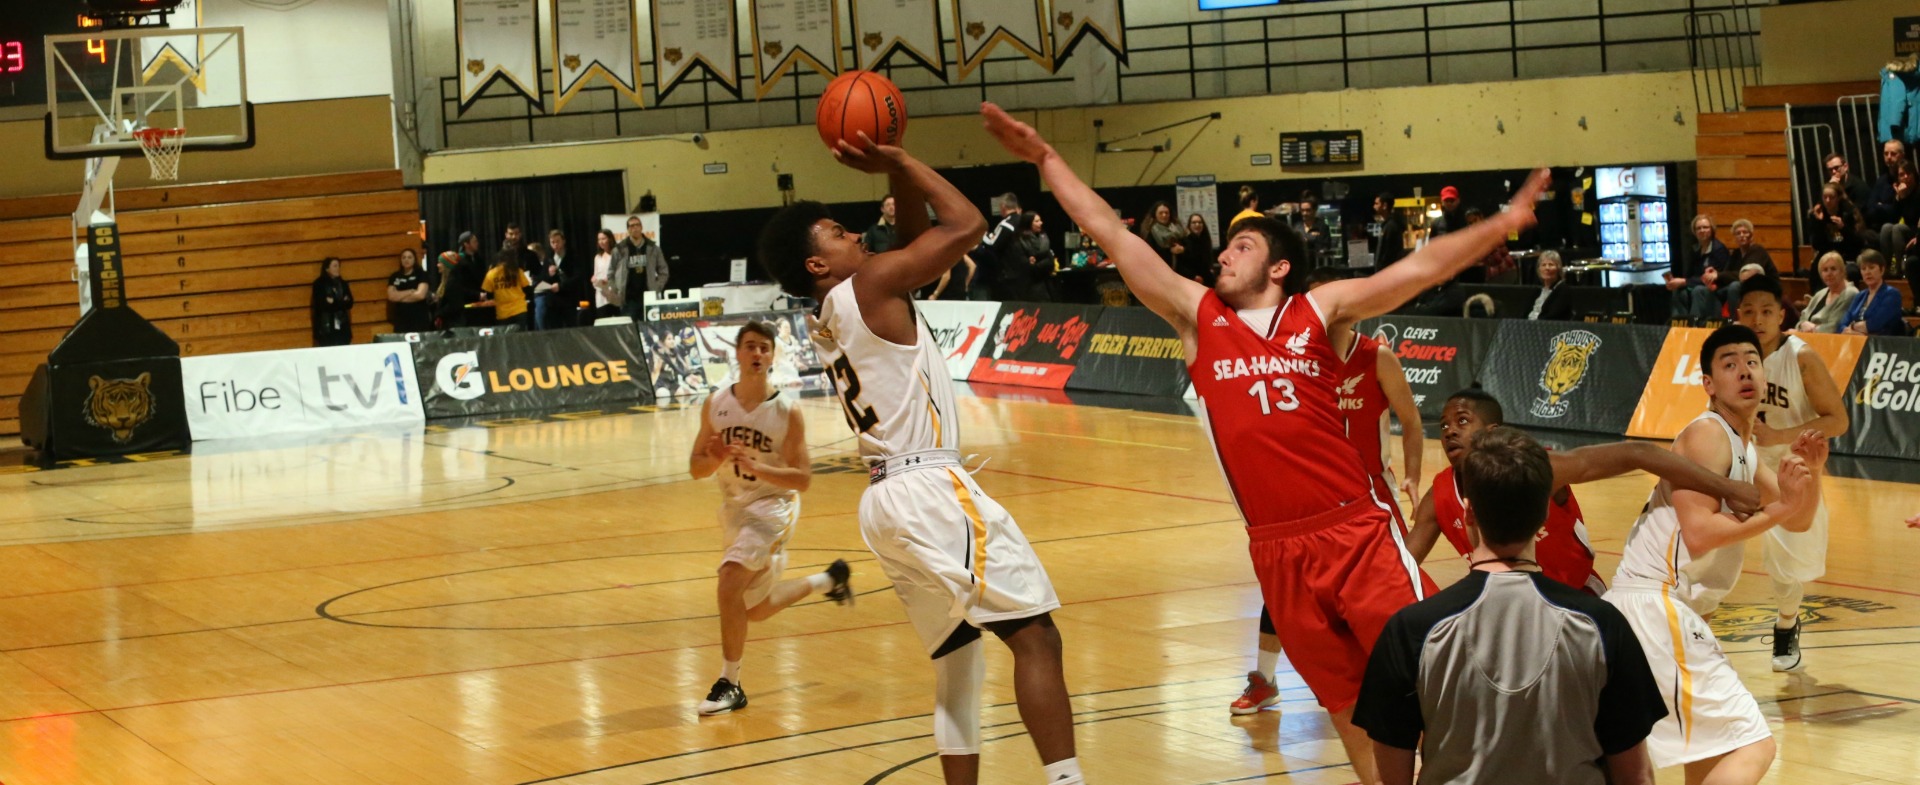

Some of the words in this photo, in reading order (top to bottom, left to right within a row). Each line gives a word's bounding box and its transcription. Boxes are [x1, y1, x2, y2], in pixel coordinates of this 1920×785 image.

[87, 38, 106, 64] 4
[95, 227, 114, 245] GO
[96, 251, 121, 308] TIGERS
[661, 310, 698, 321] LOUNGE
[1403, 326, 1438, 340] CLEVE'S
[1088, 334, 1128, 355] TIGER
[1396, 340, 1457, 361] Source
[435, 350, 486, 400] G
[488, 360, 631, 393] LOUNGE
[199, 379, 281, 414] Fibe
[1248, 378, 1300, 415] 13
[1530, 397, 1570, 418] TIGERS
